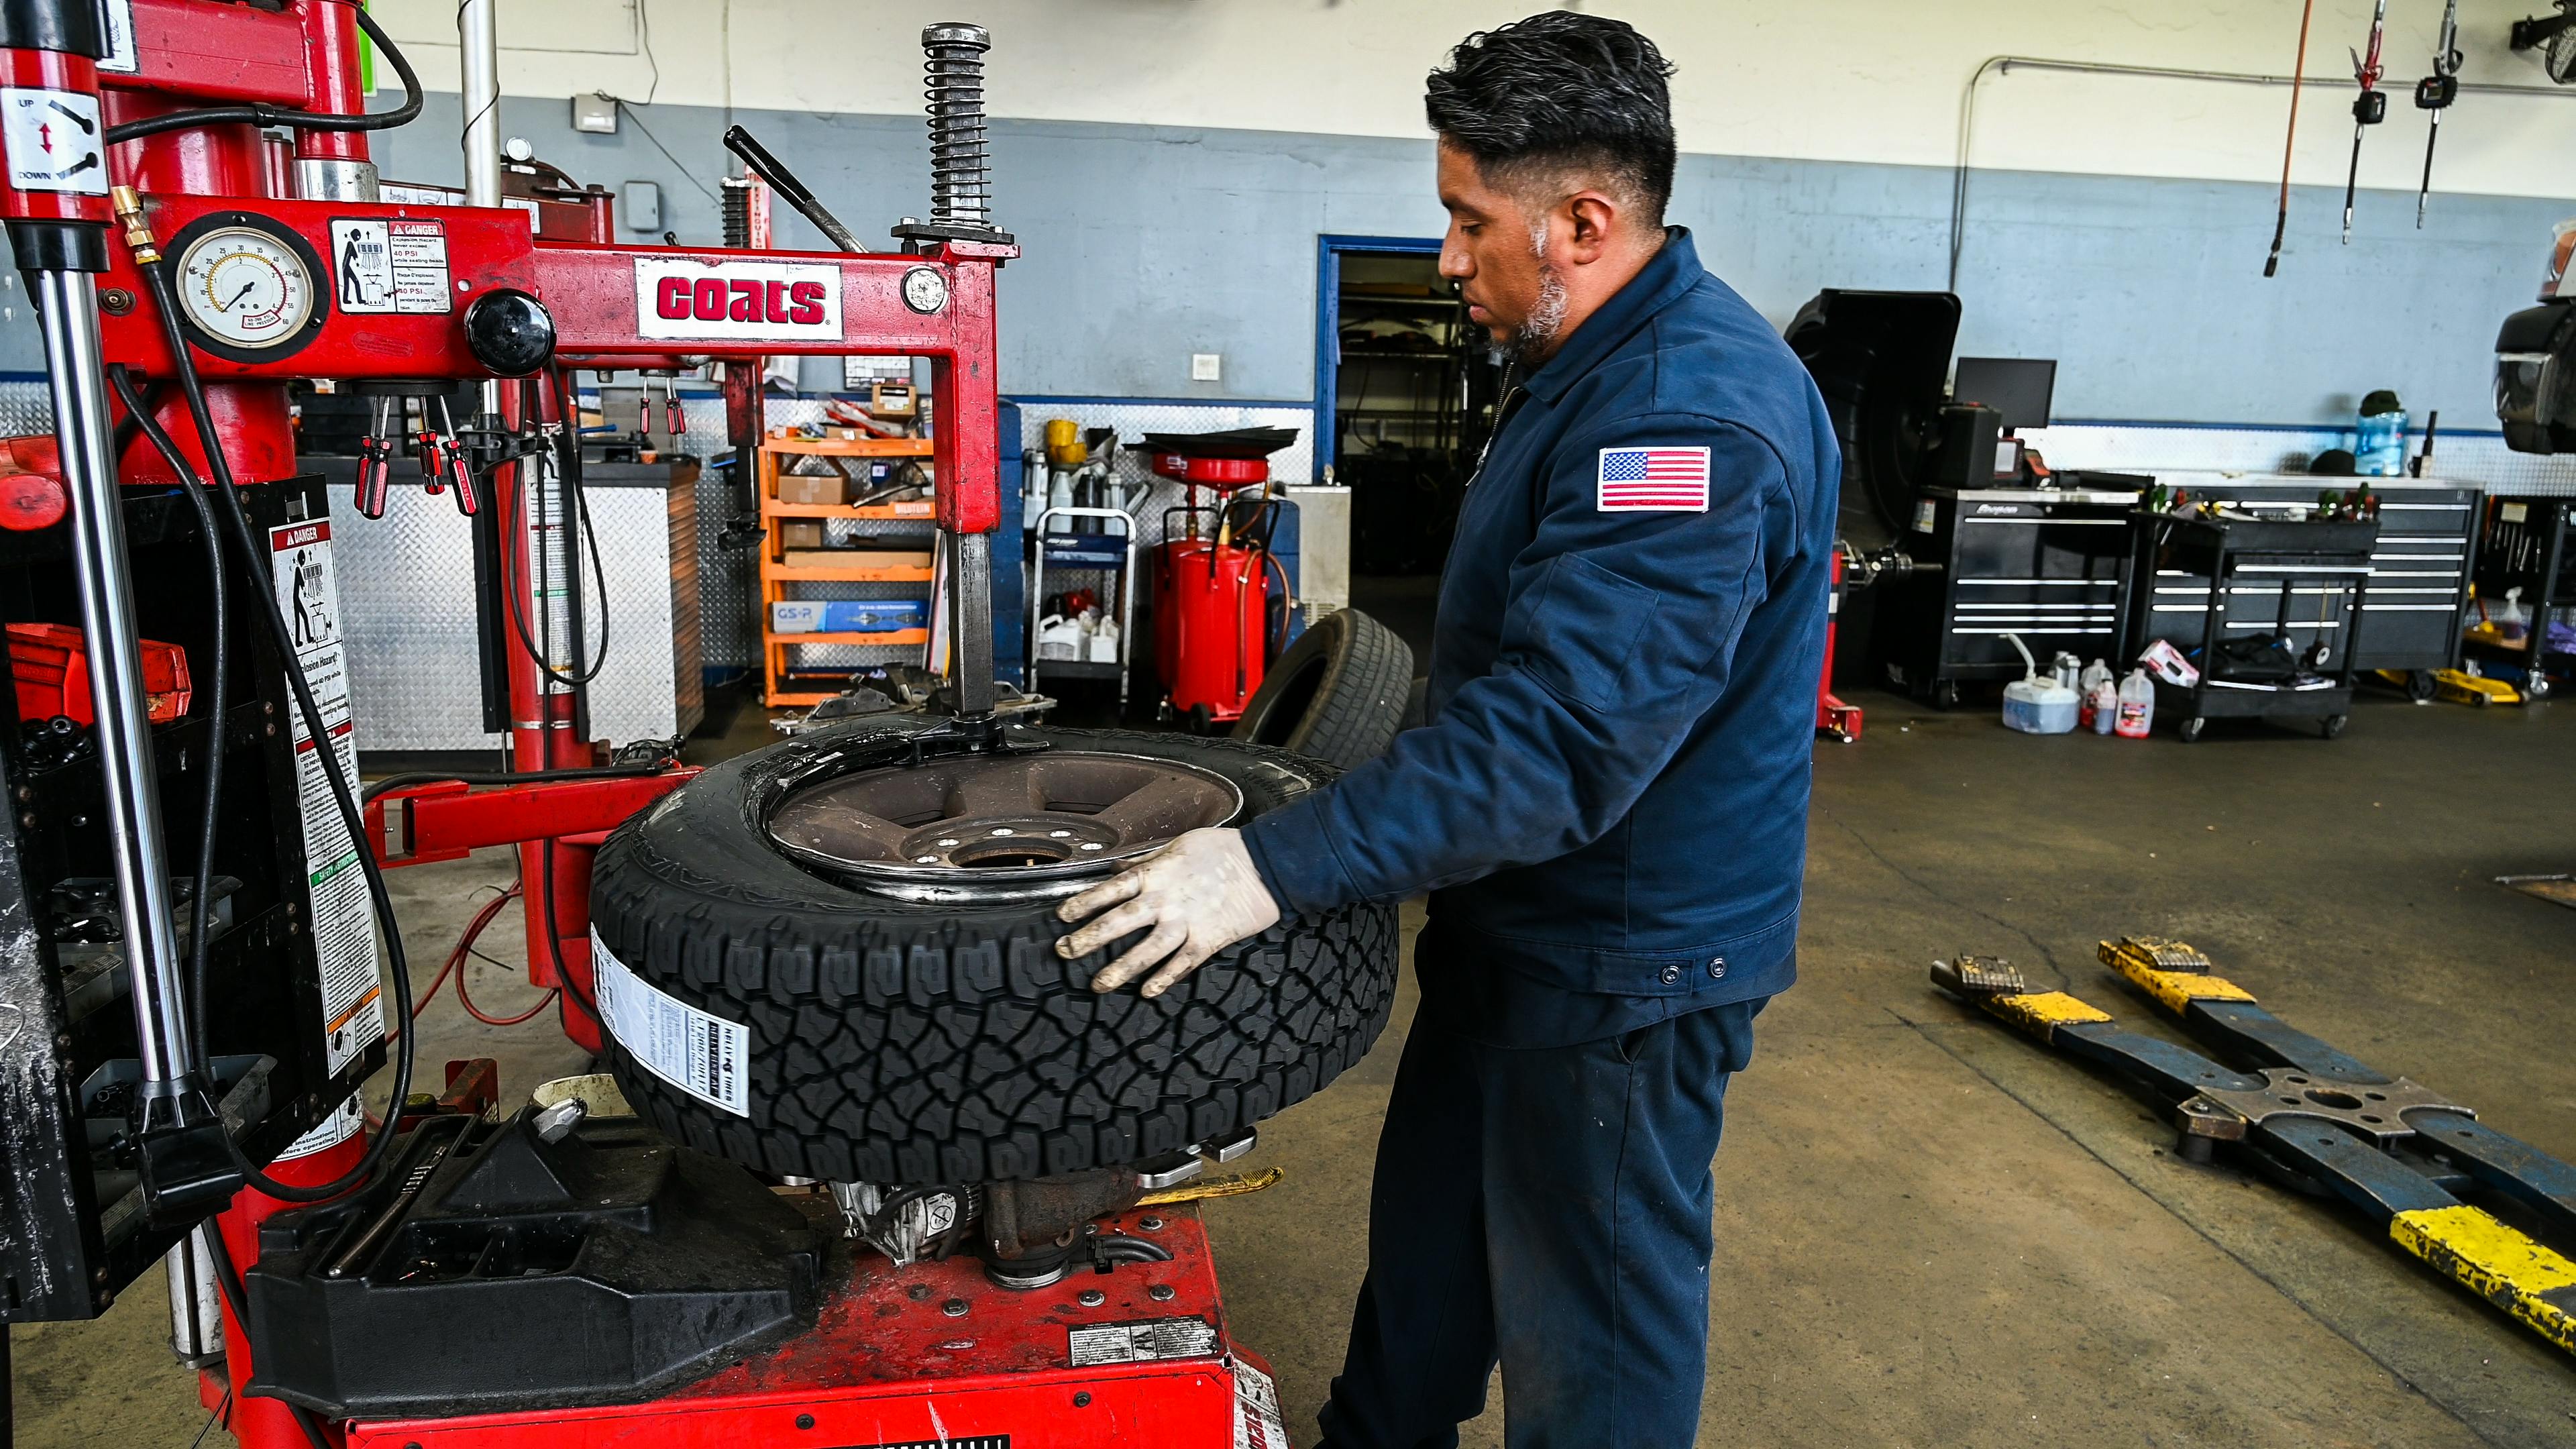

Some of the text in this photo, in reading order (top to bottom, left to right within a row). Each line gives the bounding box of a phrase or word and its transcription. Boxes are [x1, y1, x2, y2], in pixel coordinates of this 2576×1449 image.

[19, 99, 34, 107] UP
[19, 172, 51, 180] DOWN
[405, 225, 439, 235] DANGER
[656, 276, 826, 325] coats
[294, 527, 318, 543] DANGER
[295, 1130, 335, 1146] instructions
[303, 1136, 336, 1150] operating.
